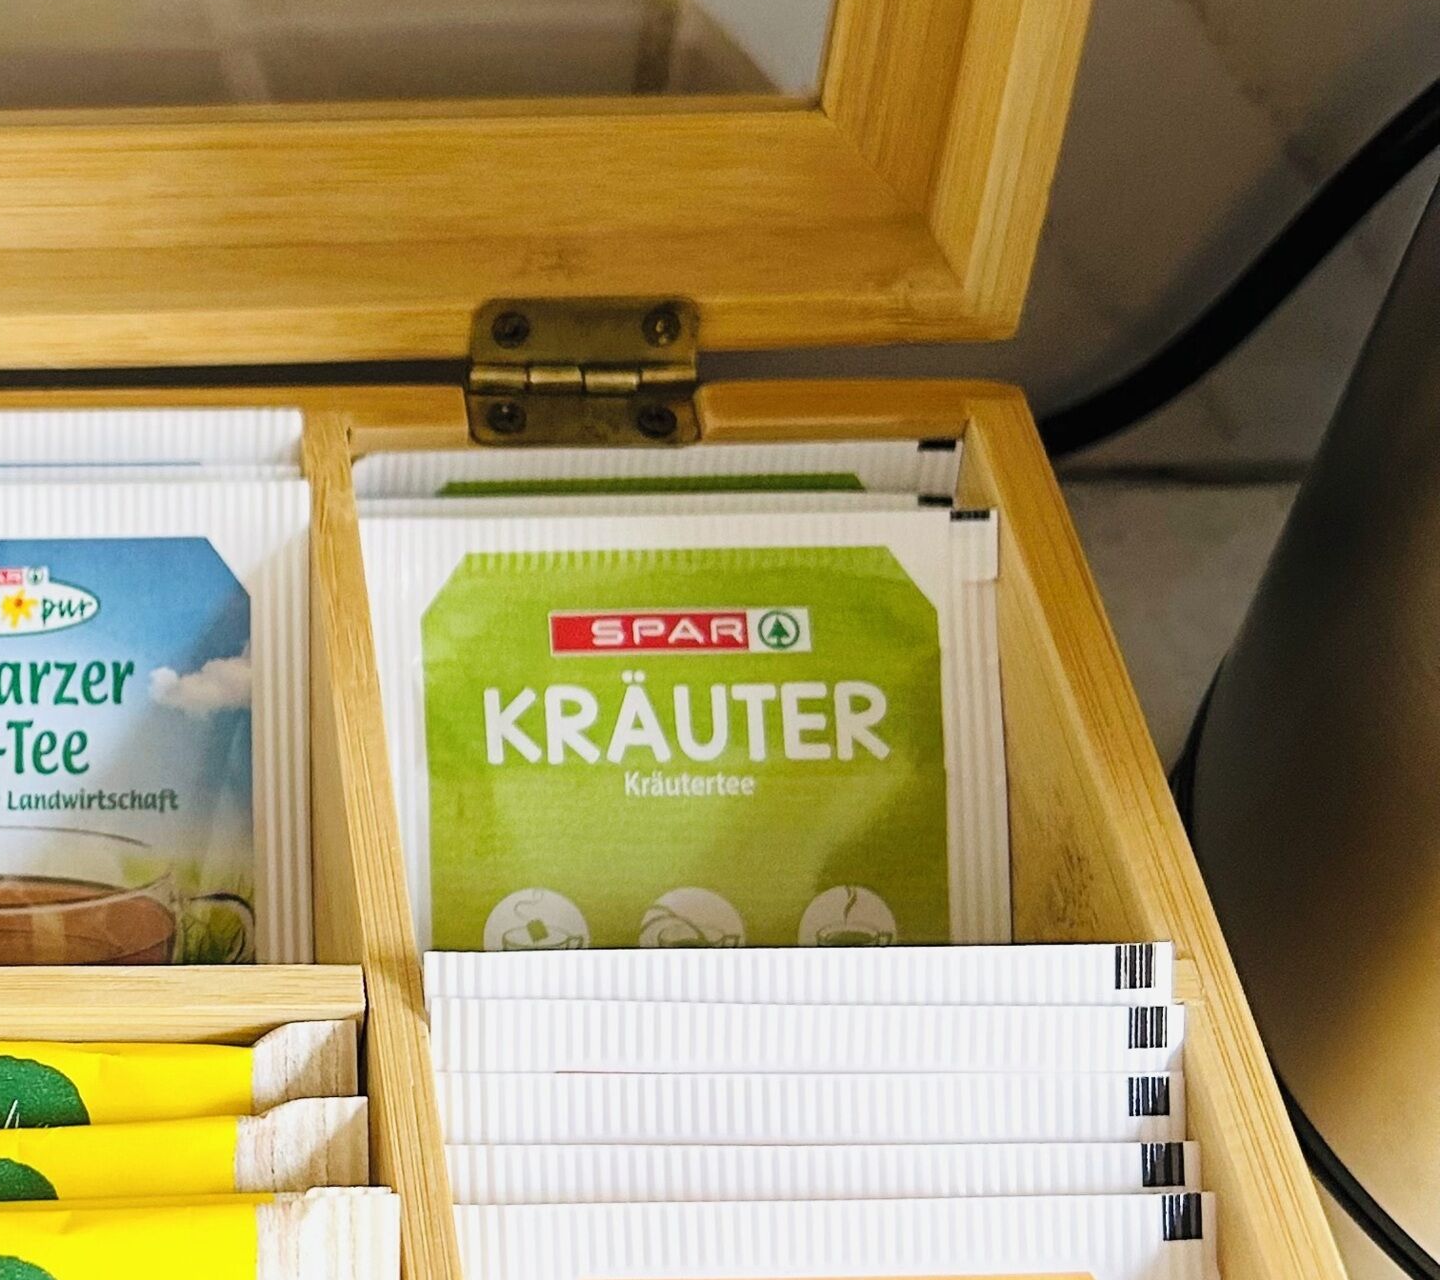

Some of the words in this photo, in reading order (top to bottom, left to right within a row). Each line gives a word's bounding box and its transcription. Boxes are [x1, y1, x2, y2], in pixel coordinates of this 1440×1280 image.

[41, 596, 93, 627] pur
[590, 617, 746, 646] SPAR
[483, 669, 891, 765] KRÄUTER
[623, 771, 756, 797] Kräutertee
[7, 787, 179, 815] Landwirtschaft
